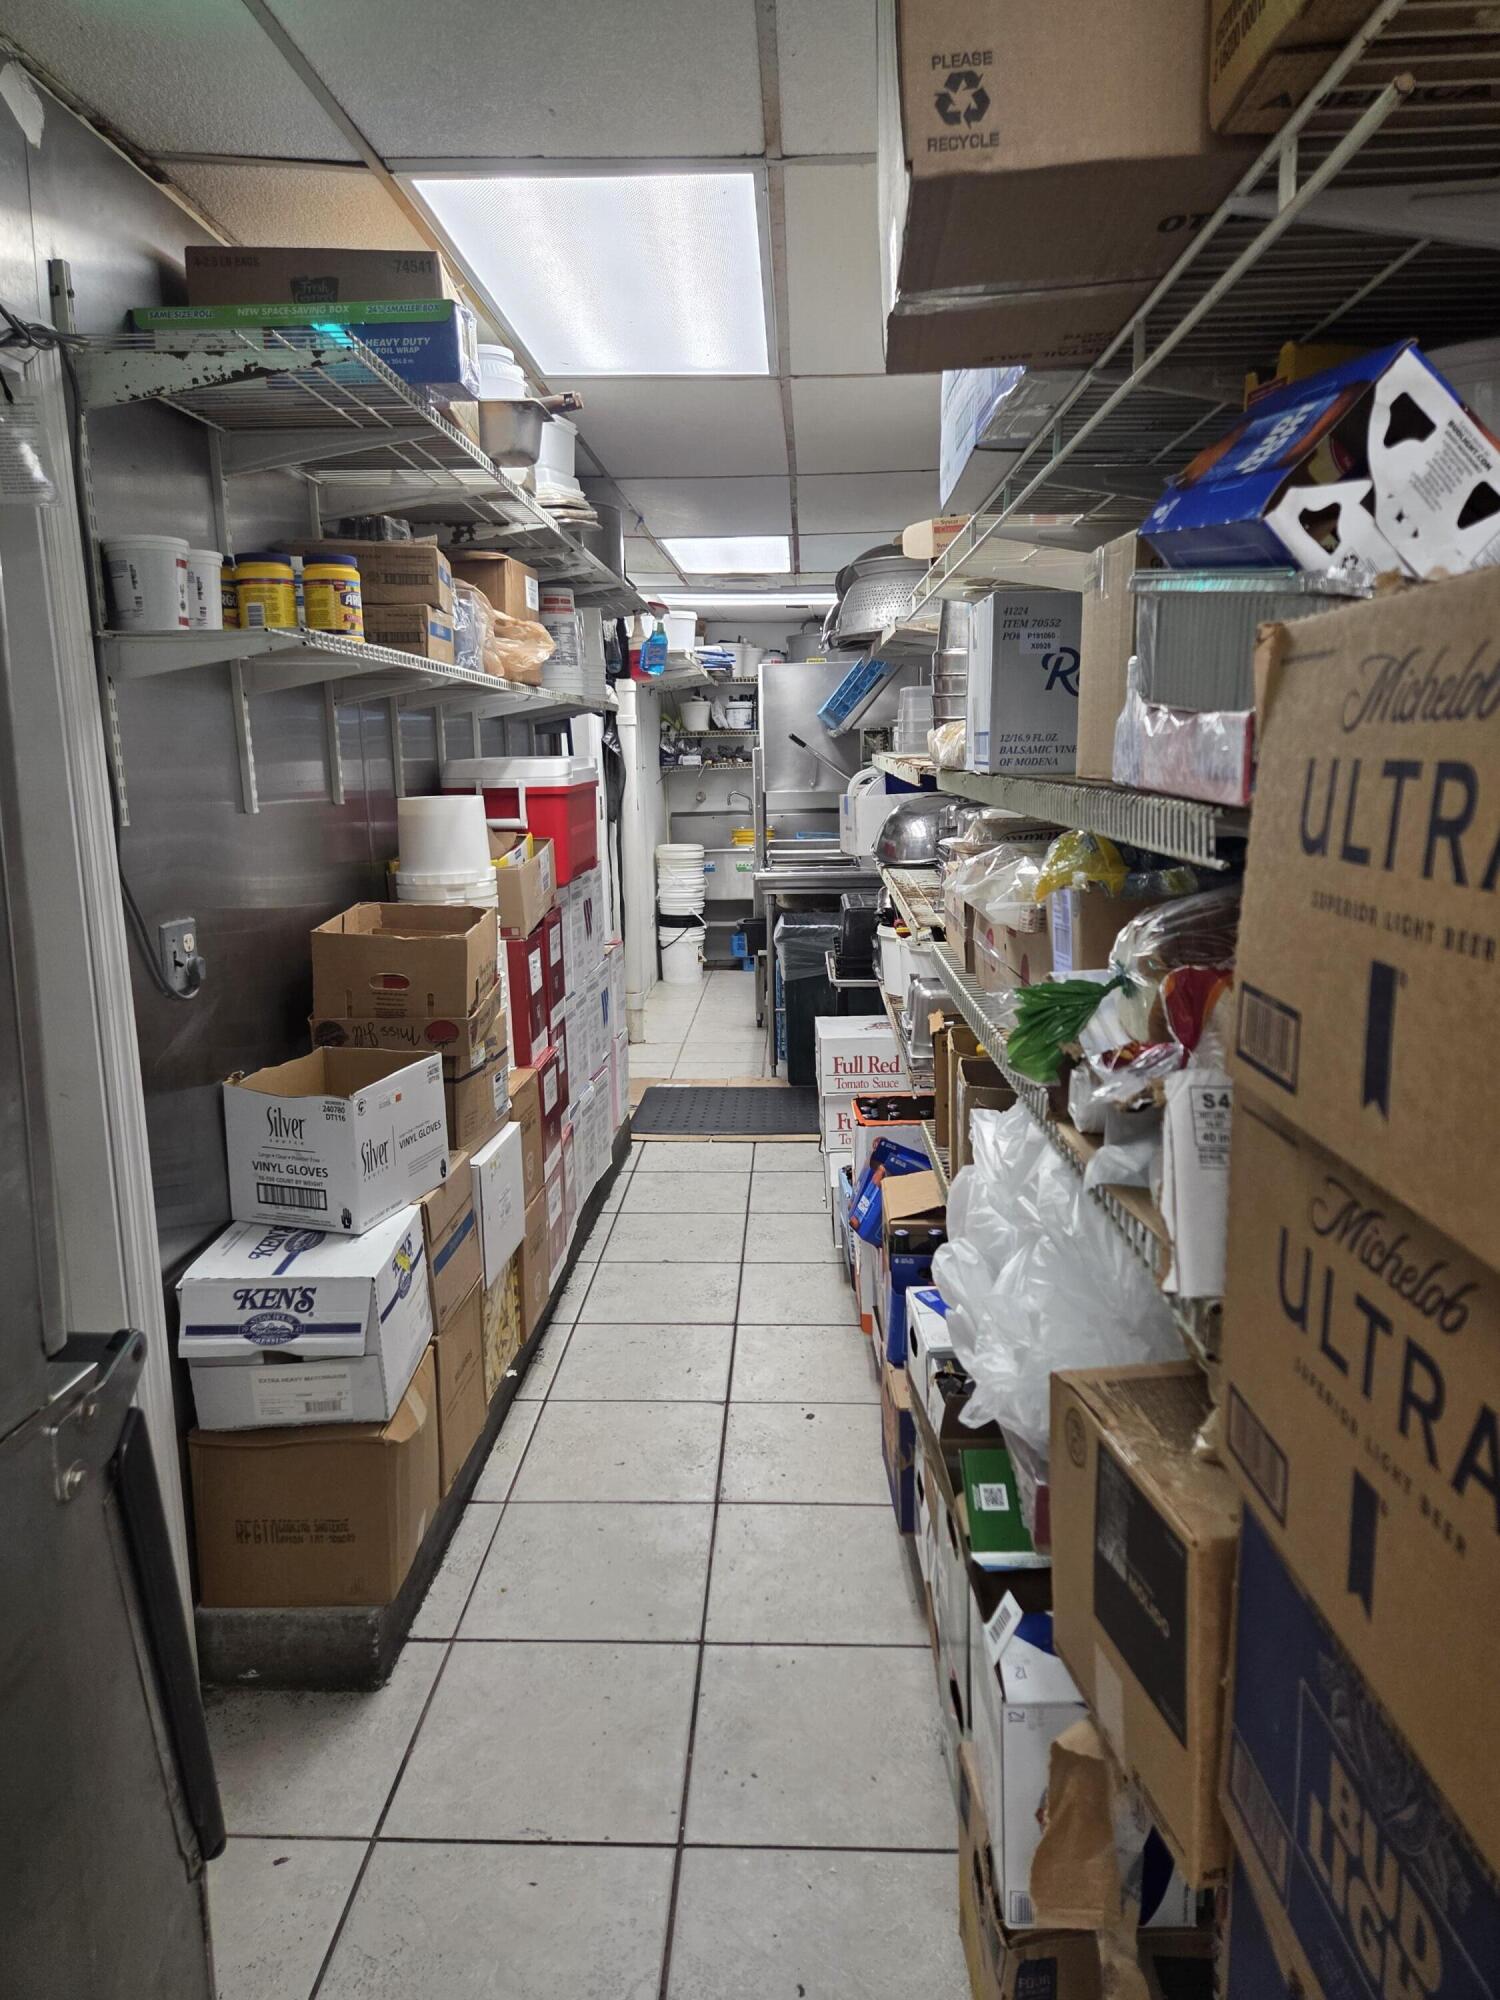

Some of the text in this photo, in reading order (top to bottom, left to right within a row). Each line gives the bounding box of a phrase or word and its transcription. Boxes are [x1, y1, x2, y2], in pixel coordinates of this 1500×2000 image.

[931, 51, 993, 69] PLEASE
[927, 132, 1000, 152] RECYCLE
[394, 259, 433, 274] 74541
[237, 305, 350, 317] NEW SPACE-SAVING BOX
[365, 337, 431, 347] HEAVY DUTY
[375, 346, 421, 355] FOIL WRAP
[1003, 606, 1029, 617] 41224
[1003, 617, 1062, 629] ITEM 70552
[999, 744, 1052, 755] BALSAMIC
[1000, 757, 1059, 768] OF MODENA
[1310, 889, 1496, 964] SUPERIOR LIGHT BEER
[832, 1055, 900, 1074] Full Red
[834, 1076, 900, 1089] Tomato Sauce
[322, 1105, 346, 1114] 240780
[325, 1113, 346, 1122] DT116
[266, 1106, 306, 1140] Silver
[399, 1134, 418, 1150] VINYL
[418, 1120, 442, 1140] GLOVES
[360, 1139, 389, 1177] Silver
[252, 1160, 329, 1178] VINYL GLOVES
[1311, 1175, 1482, 1336] Michelob
[233, 1285, 317, 1314] KEN'S
[258, 1376, 280, 1384] EXTRA
[281, 1375, 303, 1383] HEAVY
[1278, 1225, 1500, 1537] ULTRA
[1293, 1353, 1469, 1561] SUPERIOR LIGHT BEER
[1329, 1751, 1442, 1994] BUD
